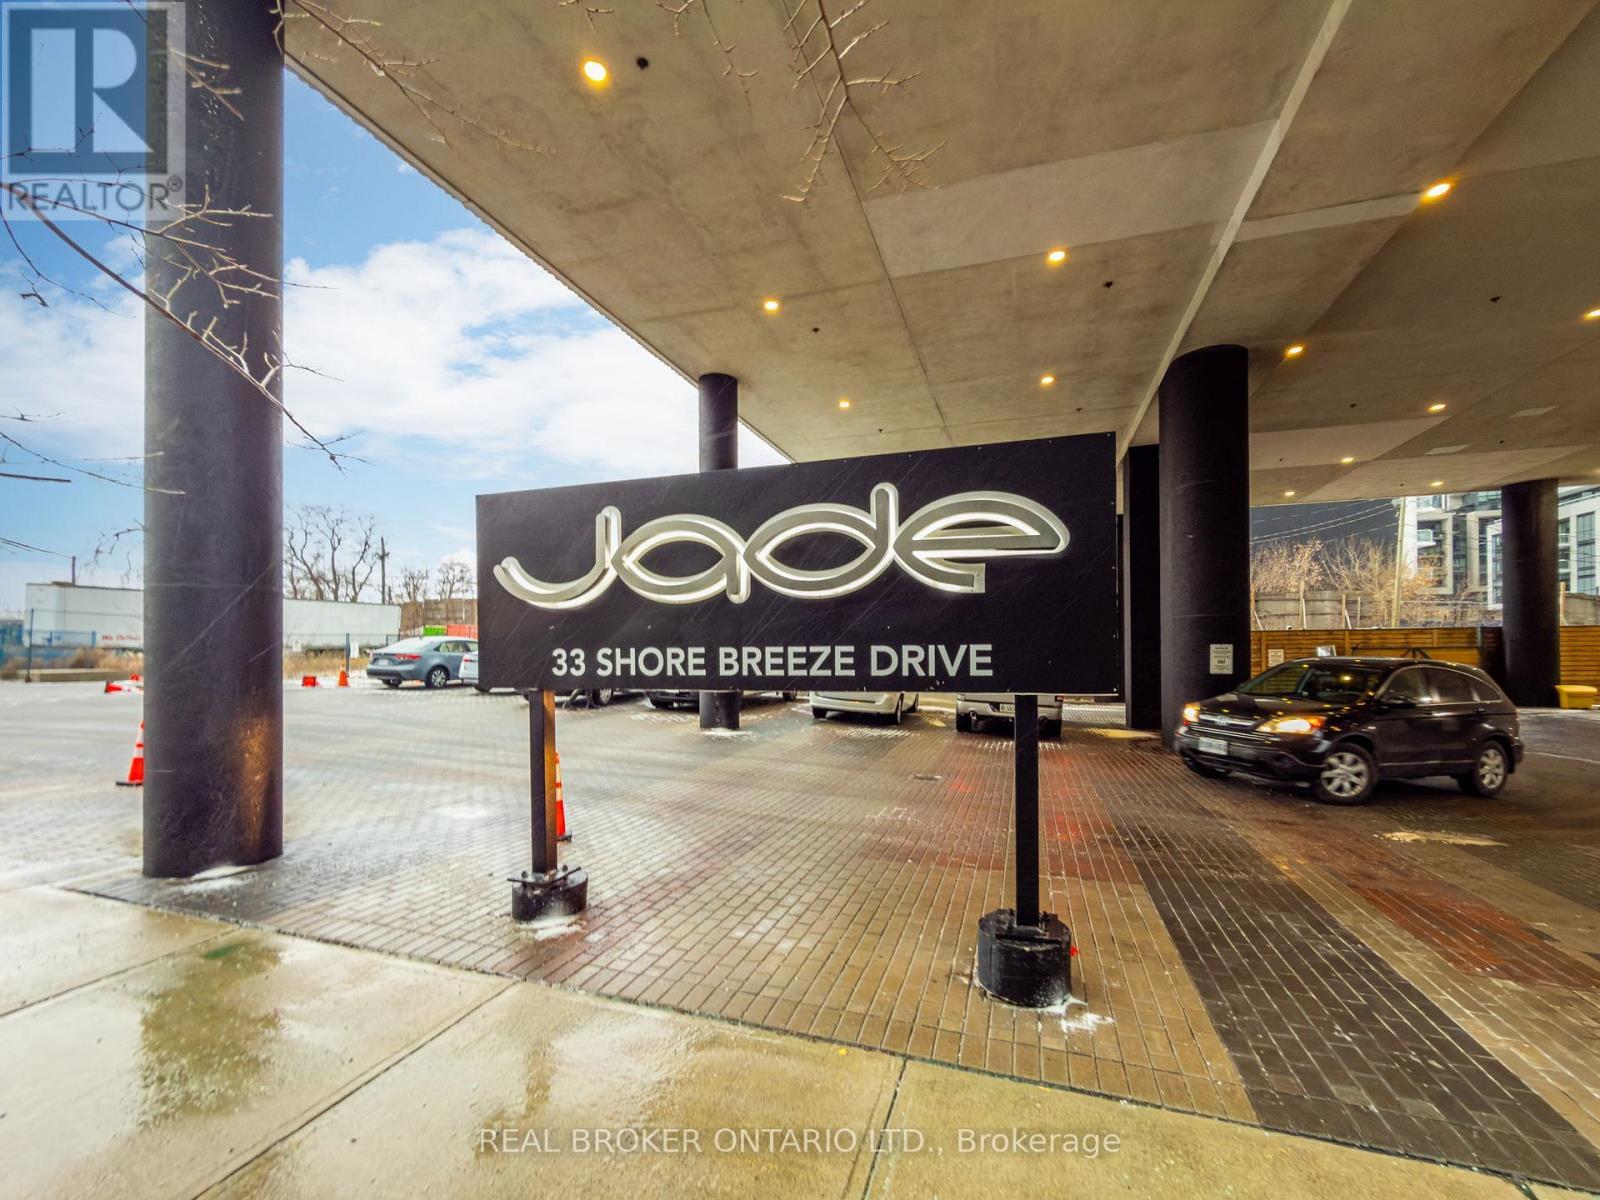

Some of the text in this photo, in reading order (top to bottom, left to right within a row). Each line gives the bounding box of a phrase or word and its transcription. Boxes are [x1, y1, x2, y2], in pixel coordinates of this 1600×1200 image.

[551, 642, 994, 678] 33 SHORE BREEZE DRIVE
